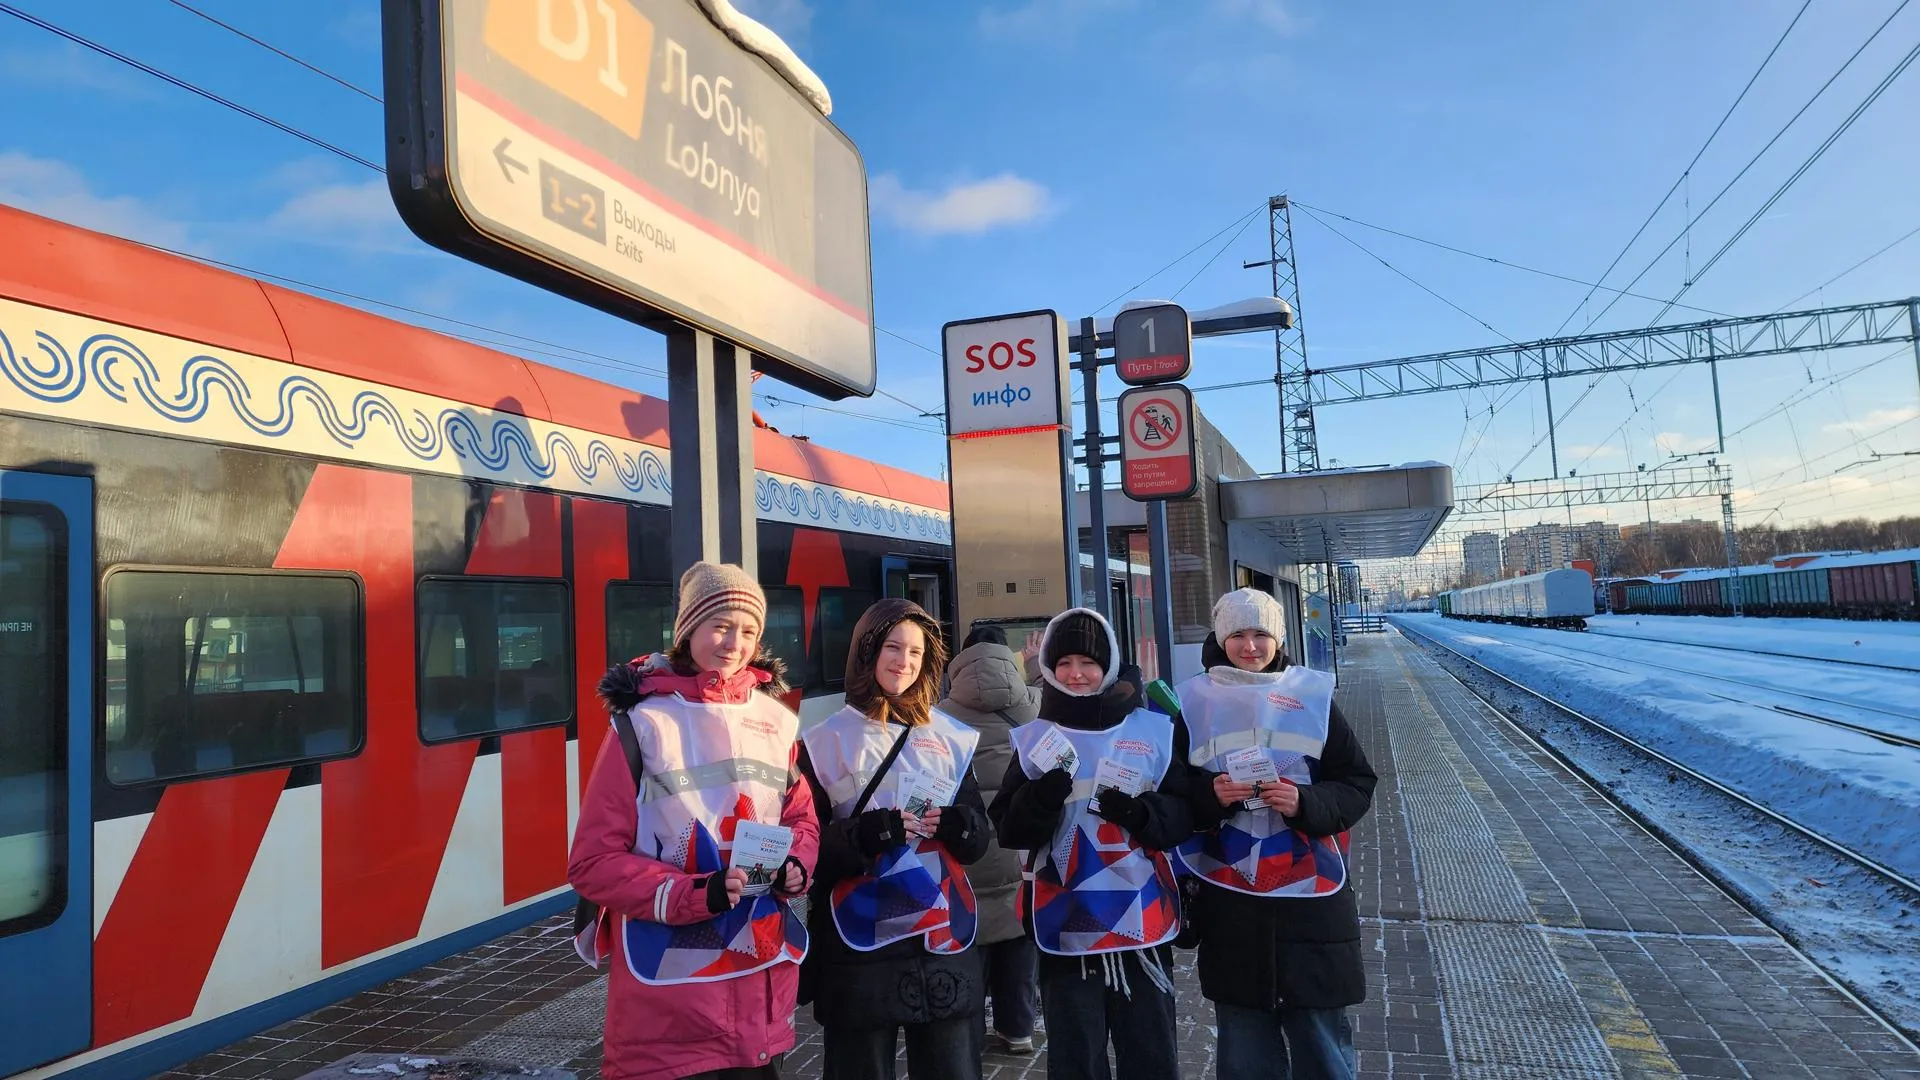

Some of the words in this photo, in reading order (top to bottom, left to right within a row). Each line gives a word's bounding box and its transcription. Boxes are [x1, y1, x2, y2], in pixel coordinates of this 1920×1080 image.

[660, 37, 768, 168] Лобня
[665, 122, 761, 220] Lobnya
[613, 198, 677, 254] Выходы
[615, 234, 644, 264] Exits
[1140, 317, 1156, 353] 1
[965, 338, 1037, 374] SOS
[1127, 363, 1153, 374] Путь
[972, 382, 1031, 408] инфо
[1132, 463, 1159, 471] Ходить
[1143, 471, 1166, 480] путям
[1133, 478, 1177, 489] запрещено!
